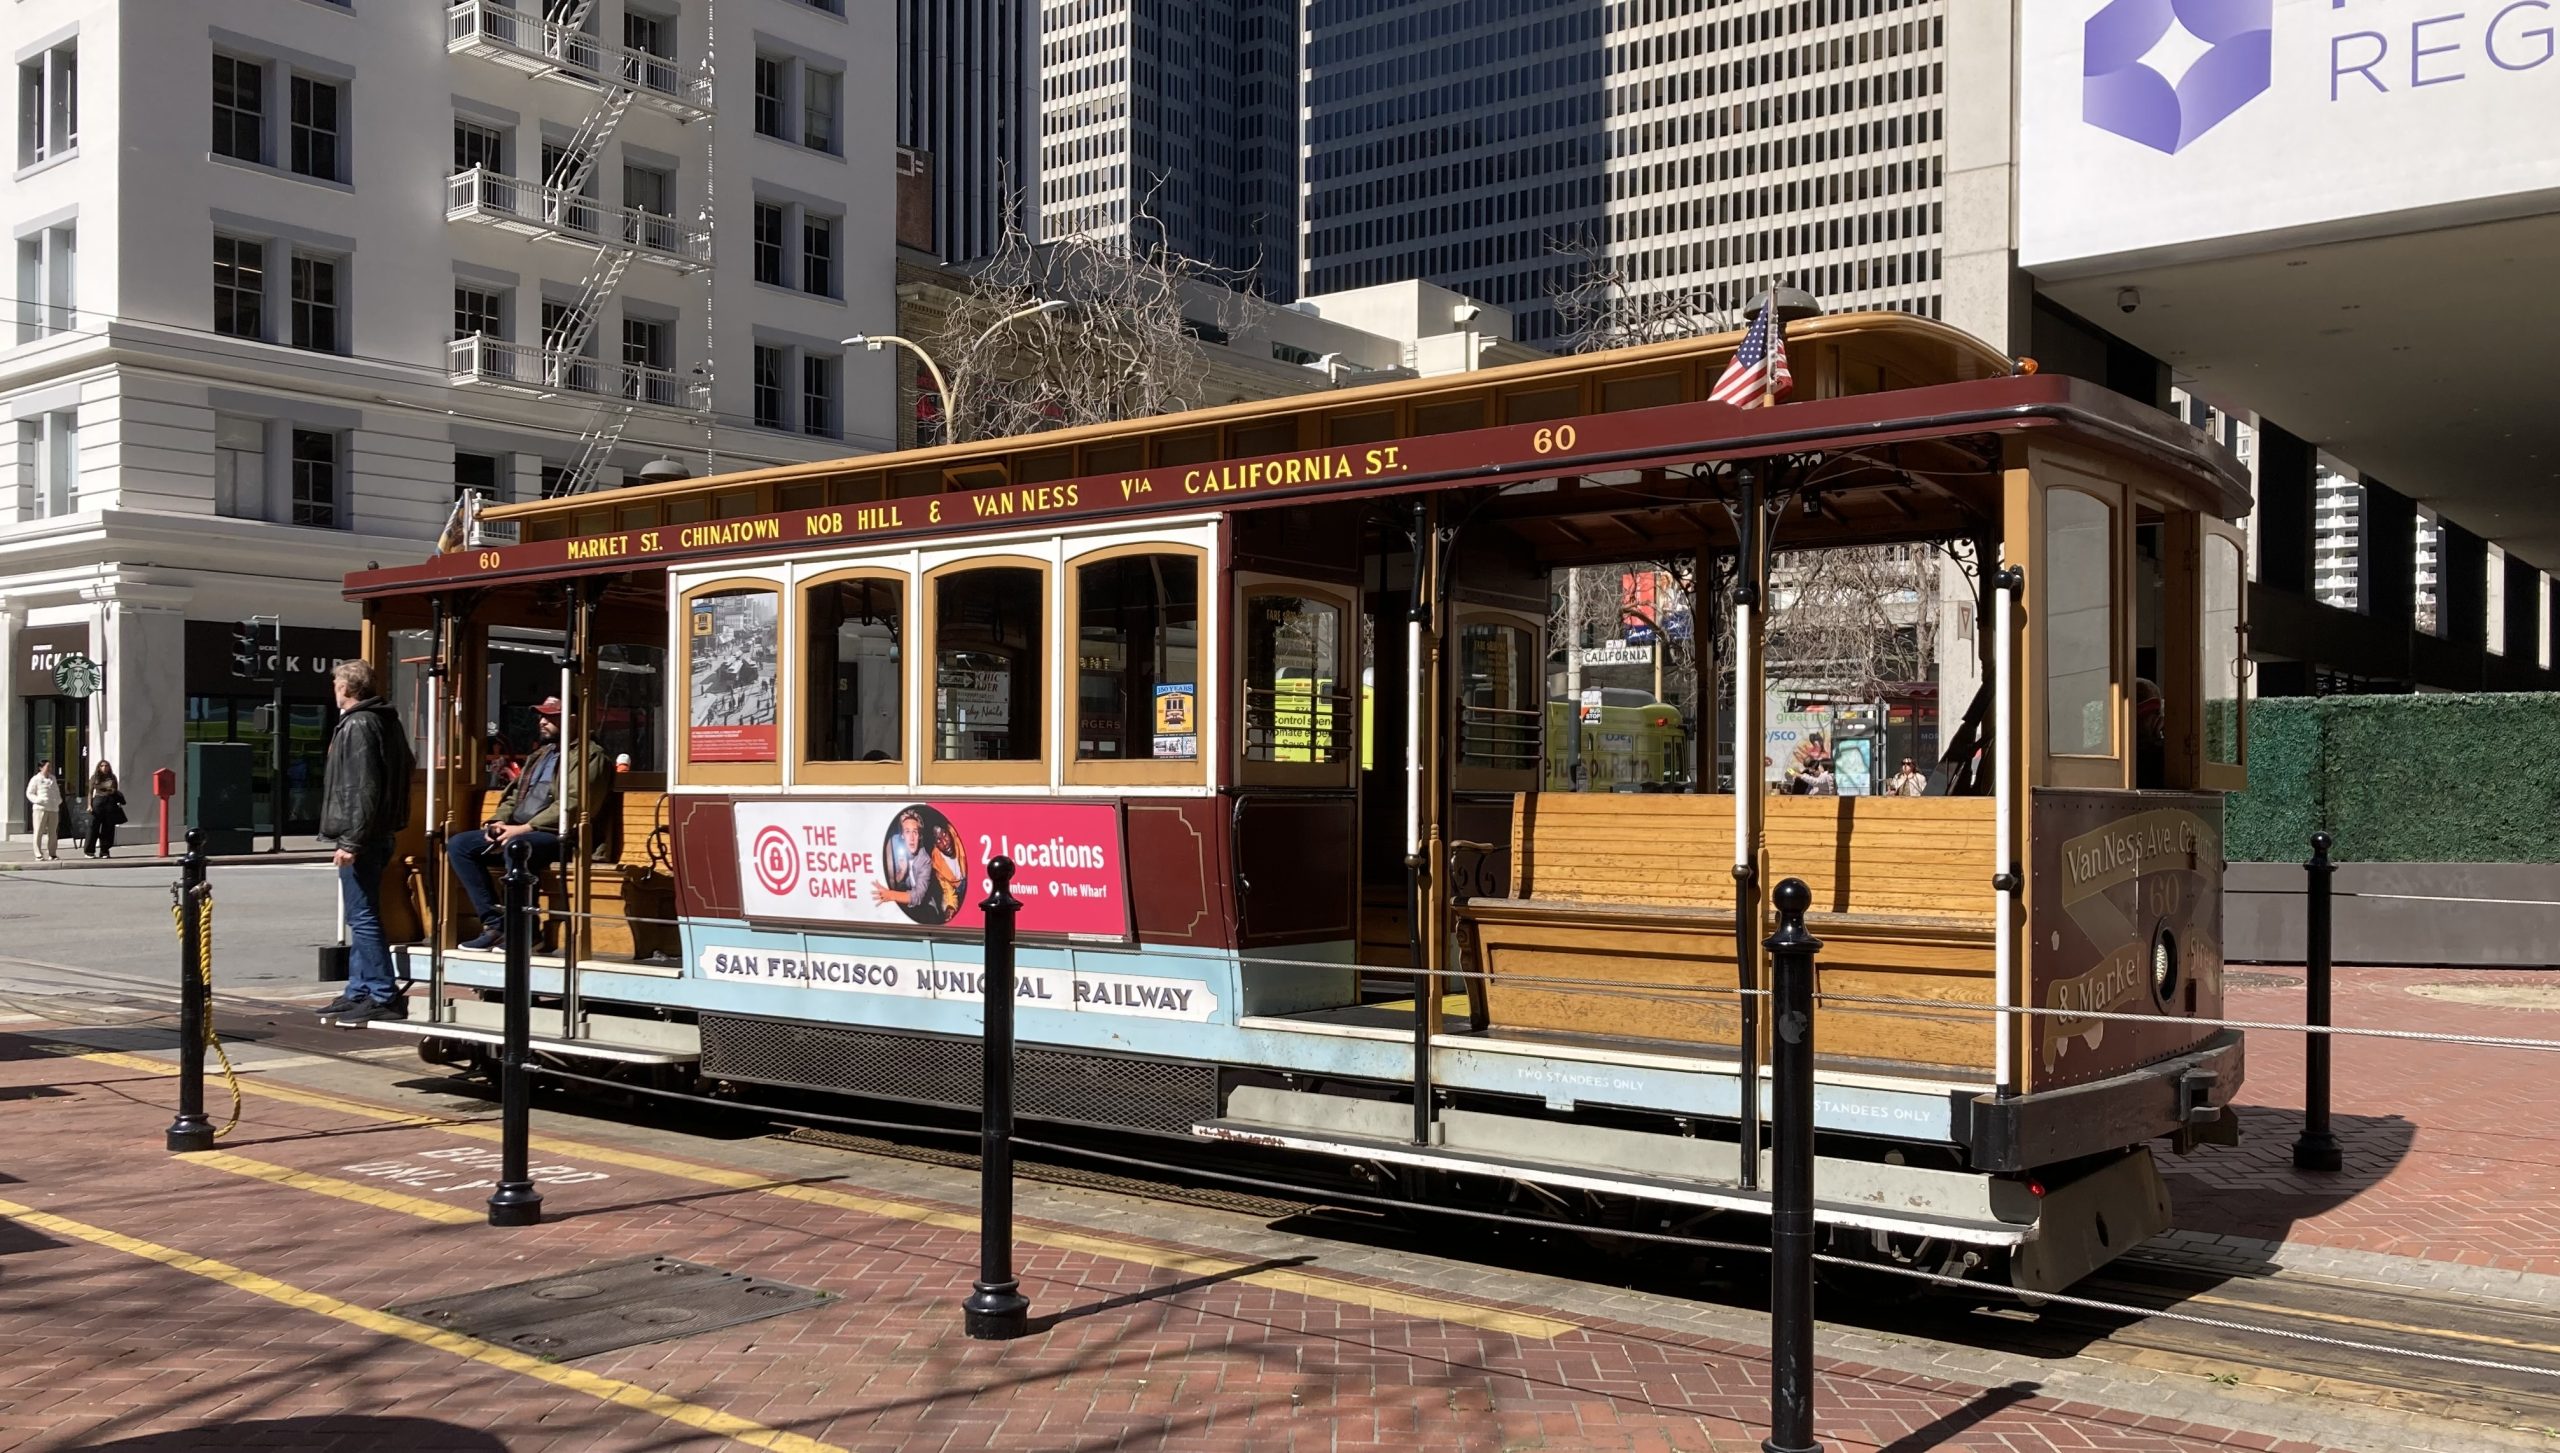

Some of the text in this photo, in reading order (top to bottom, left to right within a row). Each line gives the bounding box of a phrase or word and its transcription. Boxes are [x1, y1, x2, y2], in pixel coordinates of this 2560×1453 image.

[1533, 425, 1576, 453] 60
[568, 536, 628, 560] MARKET
[681, 518, 779, 547] CHINATOWN
[807, 512, 843, 536] NOB
[858, 506, 902, 530] HILL
[930, 500, 941, 523] &
[973, 492, 1013, 516] VAN
[1022, 484, 1078, 512] NESS
[1184, 454, 1353, 495] CALIFORNIA
[479, 551, 501, 569] 60
[1584, 650, 1648, 662] CALIFORNIA
[1169, 685, 1193, 694] YEARS
[1766, 730, 1797, 743] ysco
[802, 825, 837, 846] THE
[806, 851, 874, 874] ESCAPE
[979, 834, 1104, 869] 2 Locations
[2068, 844, 2102, 887] Van
[2103, 830, 2143, 870] Ness
[808, 877, 858, 899] GAME
[1061, 883, 1078, 897] The
[1080, 884, 1107, 898] Wharf
[2150, 873, 2180, 918] 60
[715, 953, 759, 976] SAN
[767, 957, 898, 987] FRANCISCO
[1073, 980, 1193, 1011] RAILWAY
[2058, 950, 2141, 1023] & Market
[1517, 1068, 1645, 1091] TWO STANDEES ONLY
[1814, 1100, 1930, 1122] STANDEES ONLY
